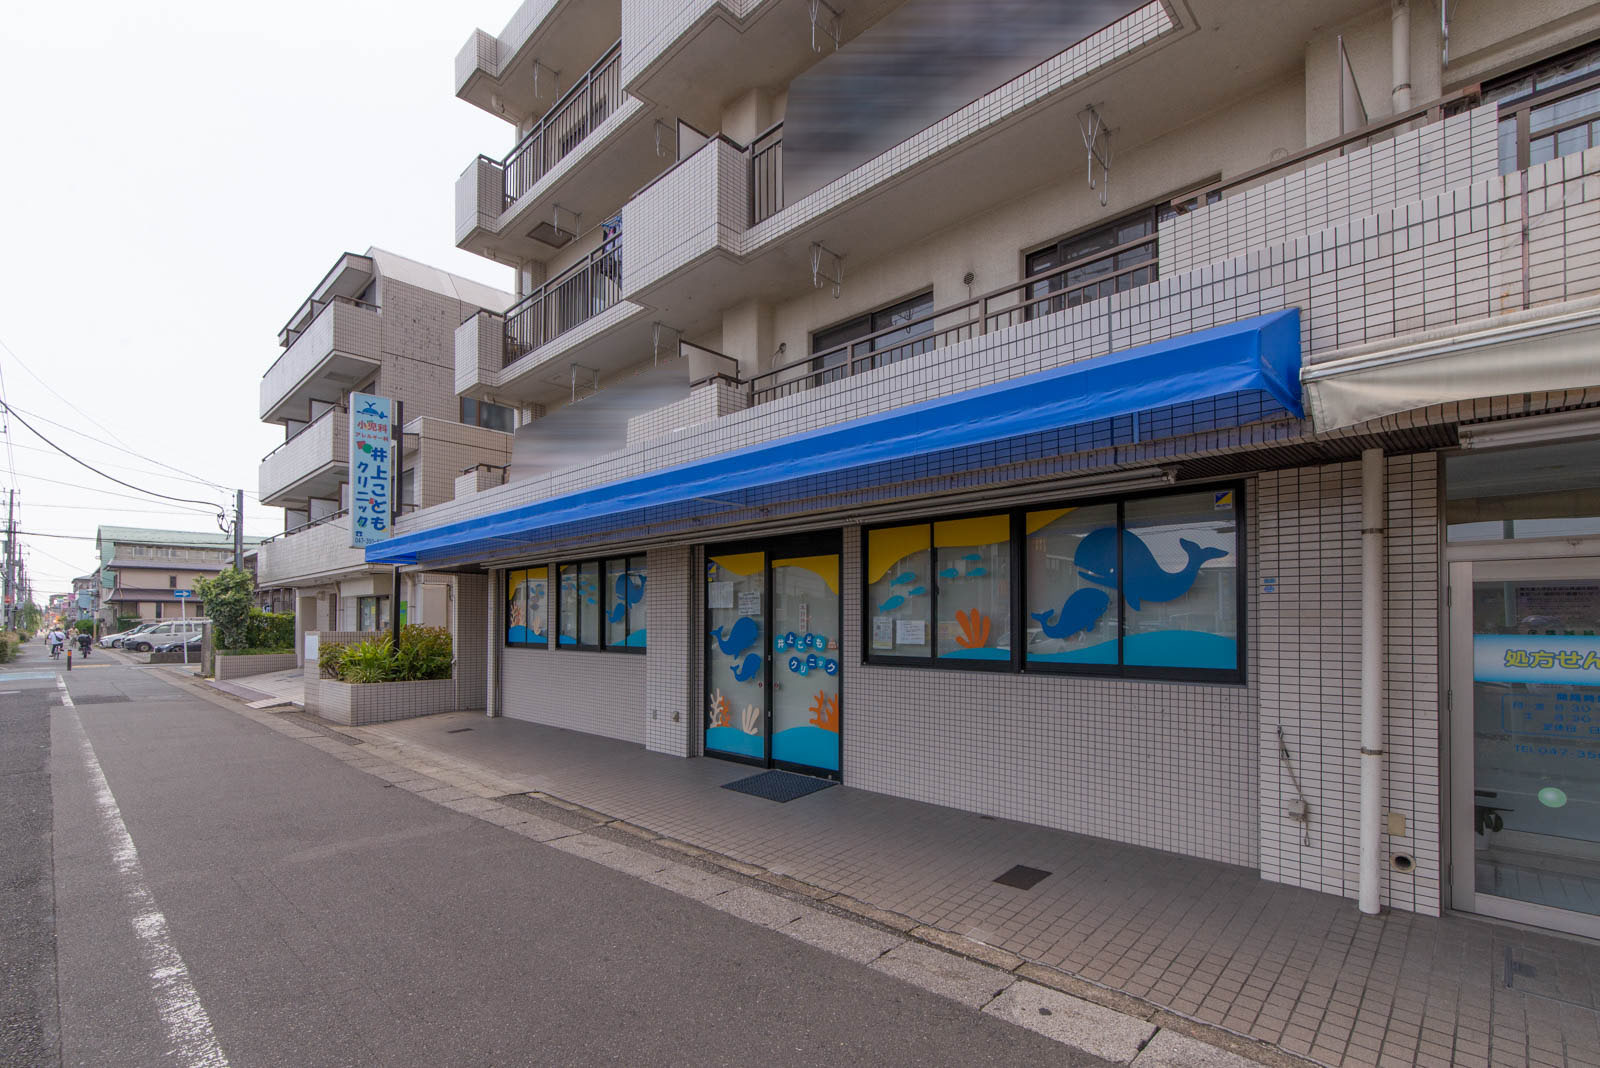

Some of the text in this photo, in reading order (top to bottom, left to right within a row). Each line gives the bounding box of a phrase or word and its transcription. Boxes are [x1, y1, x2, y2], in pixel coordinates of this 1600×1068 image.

[357, 419, 388, 434] 小児科
[355, 461, 370, 528] クリニック
[790, 658, 836, 673] クリニック
